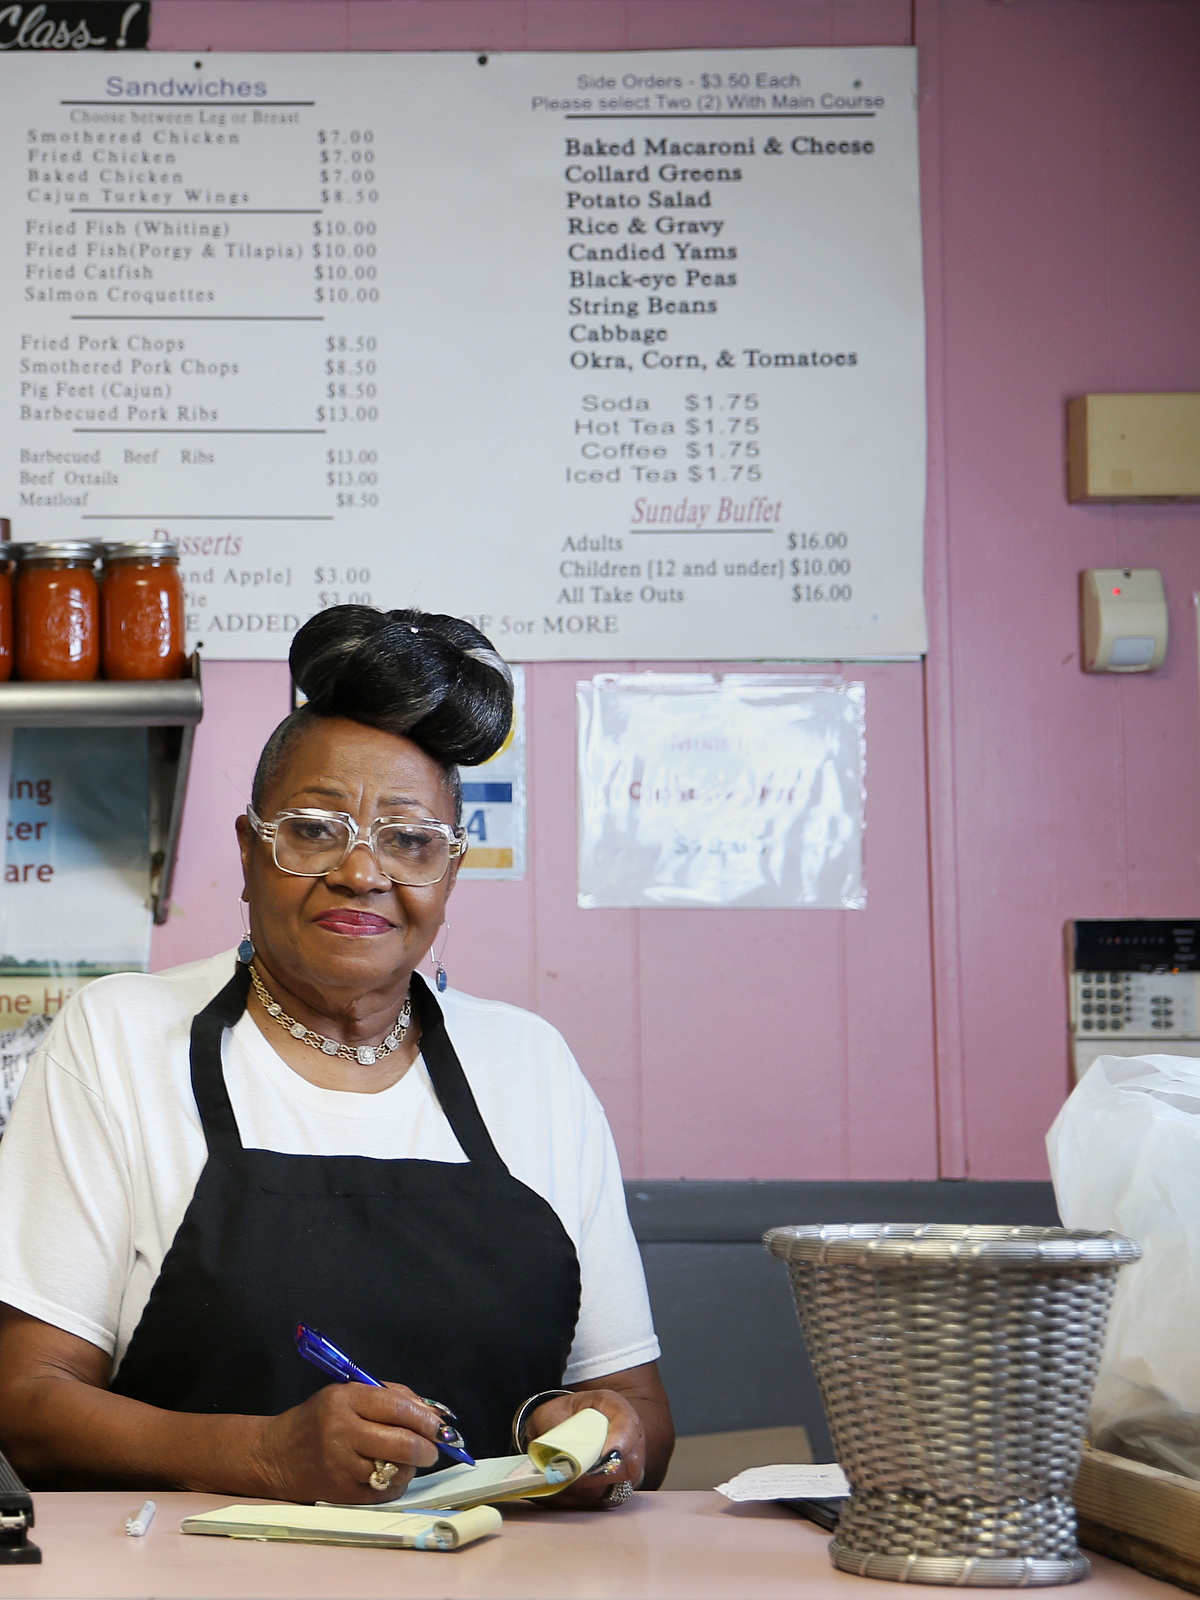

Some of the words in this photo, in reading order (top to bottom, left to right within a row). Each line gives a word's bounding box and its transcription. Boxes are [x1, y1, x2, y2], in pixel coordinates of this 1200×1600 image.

[105, 75, 268, 98] Sandwiches
[576, 73, 617, 91] Side
[622, 73, 684, 91] Orders
[700, 72, 752, 91] $3.50
[756, 72, 802, 90] Each
[531, 94, 593, 112] Please
[598, 94, 651, 111] select
[656, 93, 692, 110] Two
[697, 92, 723, 114] (2)
[726, 92, 767, 110] With
[772, 92, 815, 110] Main
[820, 92, 886, 110] Course
[565, 137, 636, 157] Baked
[644, 137, 756, 157] Macaroni
[763, 136, 783, 156] &
[790, 136, 875, 156] Cheese
[564, 164, 651, 184] Collard
[657, 163, 743, 183] Greens
[566, 191, 641, 210] Potato
[648, 190, 712, 209] Salad
[567, 217, 619, 235] Rice
[627, 216, 647, 235] &
[654, 215, 725, 238] Gravy
[567, 242, 666, 262] Candied
[673, 242, 738, 261] Yams
[25, 263, 76, 280] Fried
[83, 263, 154, 280] Catfish
[314, 264, 378, 282] $10.00
[569, 270, 676, 291] Black-eye
[685, 268, 738, 288] Peas
[568, 296, 639, 319] String
[647, 296, 718, 315] Beans
[20, 333, 70, 351] Fried
[77, 334, 119, 352] Pork
[126, 334, 185, 355] Chops
[568, 324, 668, 346] Cabbage
[19, 357, 123, 375] Smothered
[130, 357, 173, 375] Pork
[180, 358, 239, 378] Chops
[569, 351, 633, 371] Okra,
[641, 350, 707, 371] Corn,
[715, 349, 736, 369] &
[742, 349, 858, 368] Tomatoes
[581, 394, 650, 413] Soda
[685, 392, 760, 413] $1.75
[574, 419, 620, 436] Hot
[629, 417, 676, 436] Tea
[685, 416, 760, 436] $1.75
[580, 441, 668, 460] Coffee
[685, 440, 761, 460] $1.75
[566, 466, 621, 484] Iced
[632, 465, 678, 483] Tea
[687, 464, 762, 484] $1.75
[630, 496, 711, 529] Sunday
[716, 495, 783, 524] Buffet
[152, 528, 243, 556] Dsserts
[561, 534, 624, 553] Adults
[787, 531, 849, 551] $16.00
[558, 560, 642, 579] Children
[682, 558, 718, 578] and
[790, 557, 852, 577] $10.00
[557, 586, 584, 604] All
[589, 585, 634, 604] Take
[639, 585, 685, 604] Outs
[791, 583, 853, 603] $16.00
[543, 614, 621, 635] MORE
